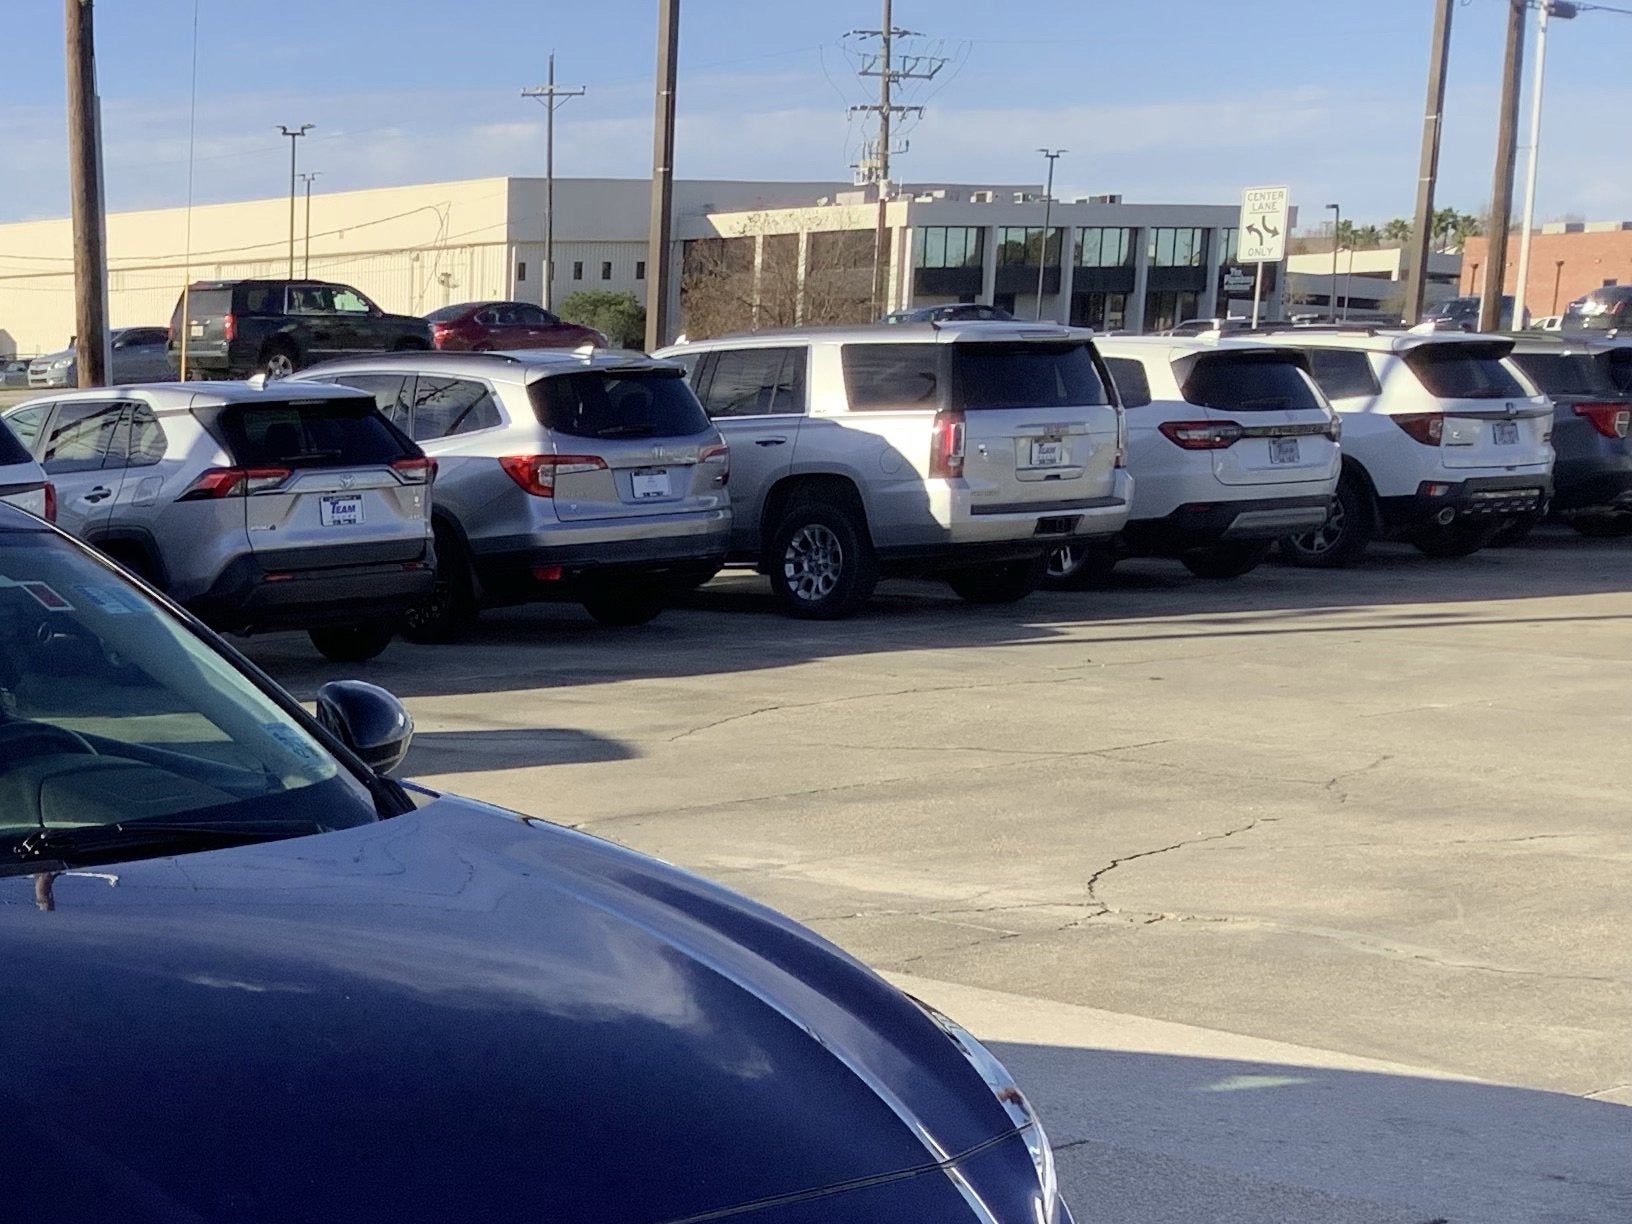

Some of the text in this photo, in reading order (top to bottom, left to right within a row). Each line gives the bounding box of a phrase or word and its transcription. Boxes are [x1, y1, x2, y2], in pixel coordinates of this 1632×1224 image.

[1247, 191, 1284, 202] CENTER
[1252, 202, 1277, 212] LANE
[1248, 248, 1273, 257] ONLY
